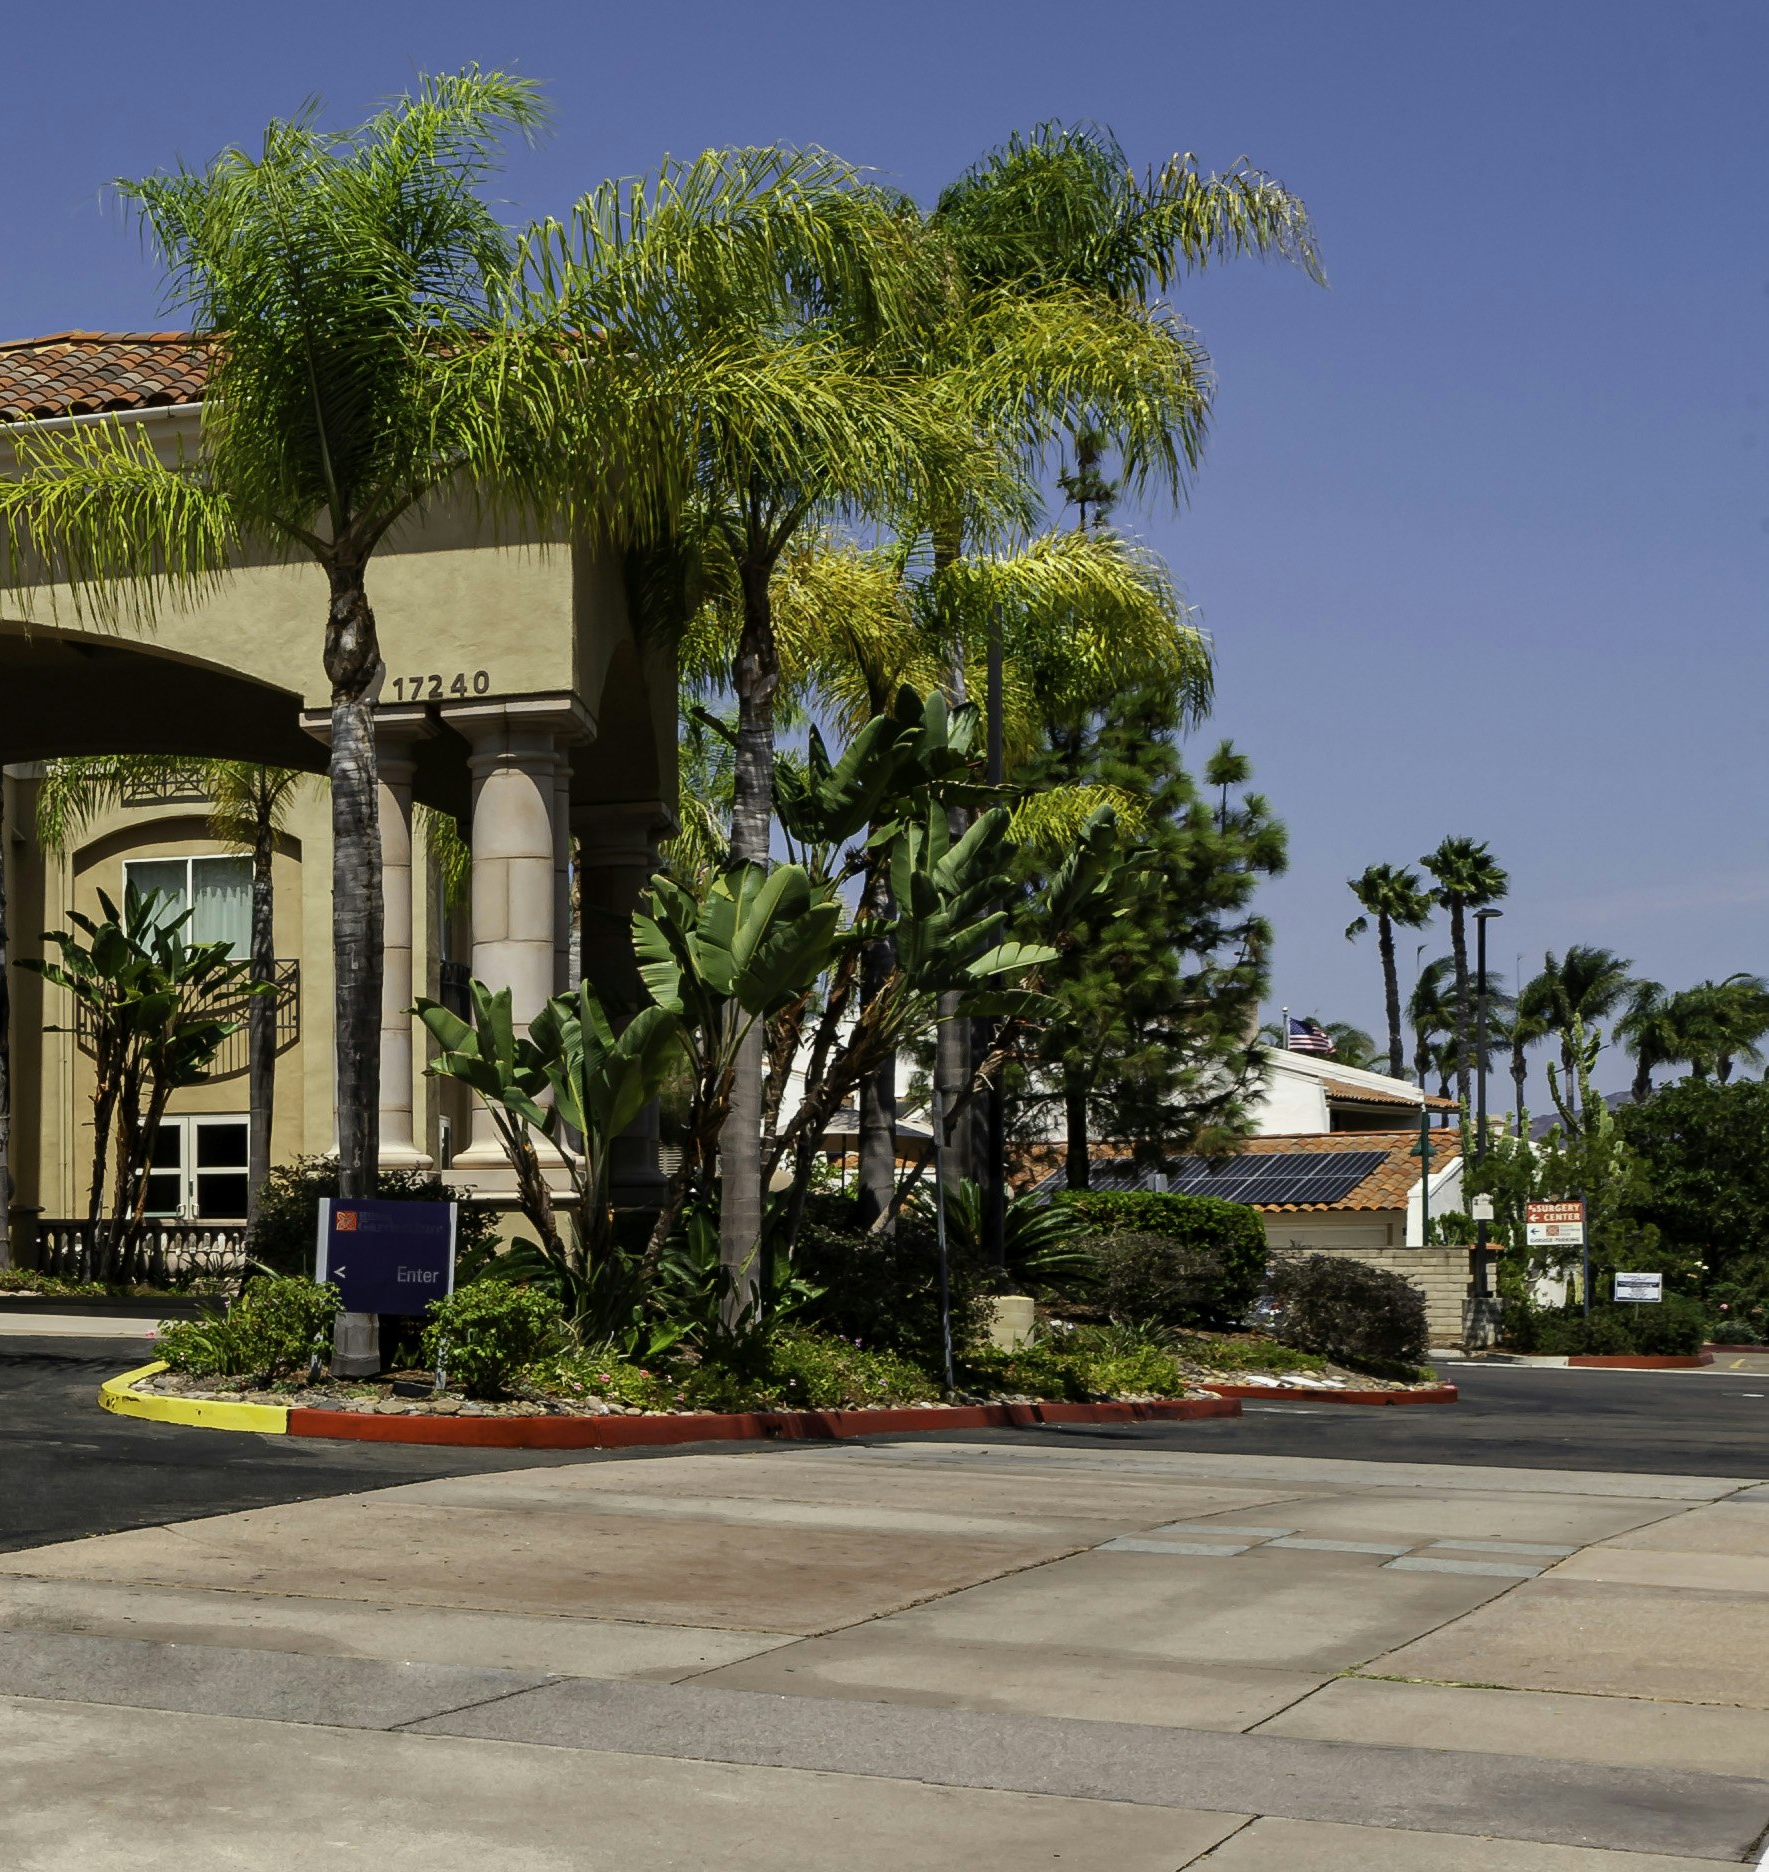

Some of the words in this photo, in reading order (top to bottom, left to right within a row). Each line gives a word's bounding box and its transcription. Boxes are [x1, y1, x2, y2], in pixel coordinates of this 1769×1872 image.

[392, 669, 490, 701] 17240
[1536, 1203, 1580, 1213] SURGERY
[1543, 1212, 1581, 1222] CENTER
[396, 1265, 440, 1284] Enter
